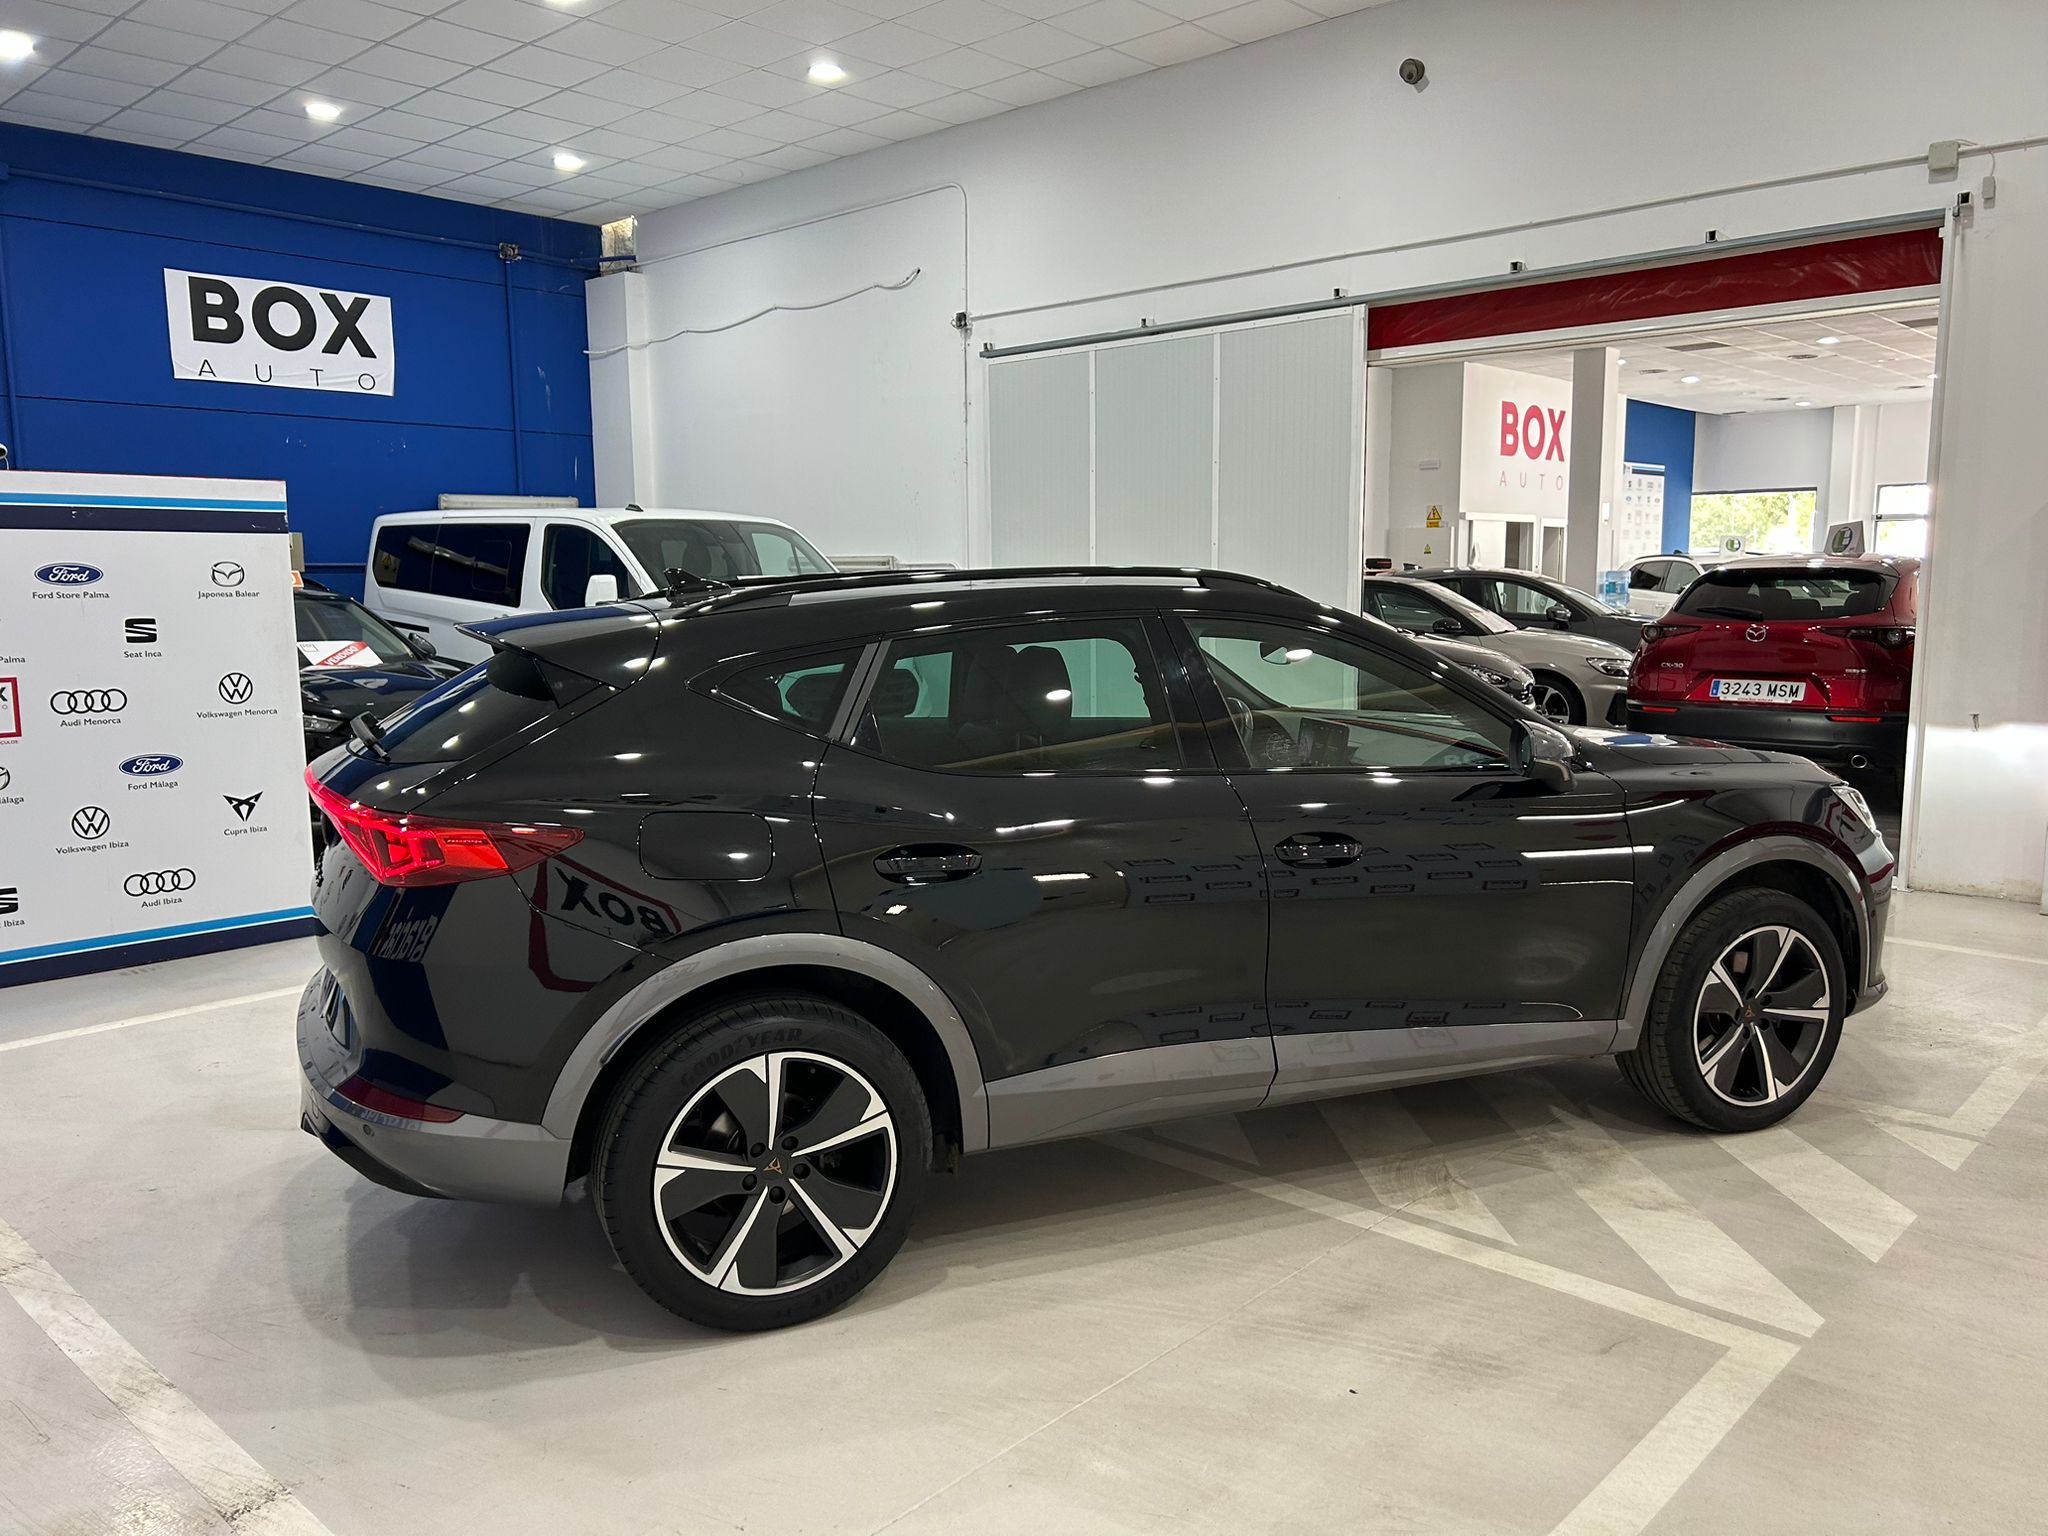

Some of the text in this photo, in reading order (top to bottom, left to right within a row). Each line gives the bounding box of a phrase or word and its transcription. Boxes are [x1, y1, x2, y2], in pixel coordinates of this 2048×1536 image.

[188, 276, 377, 359] BOX
[199, 359, 376, 391] AUTO
[1500, 400, 1566, 462] BOX
[1499, 470, 1564, 491] AUTO
[48, 566, 90, 582] Ford
[32, 591, 110, 599] Ford Store Palma
[198, 590, 260, 599] Japonesa Balear
[1720, 682, 1800, 699] 3243 MSM
[196, 708, 278, 719] Volkswagen Menorca
[60, 718, 121, 727] Audi Menorca
[132, 757, 171, 773] Ford
[127, 782, 148, 790] Ford
[223, 828, 248, 836] Cupra
[55, 841, 130, 855] Volkswagen Ibiza
[141, 897, 183, 908] Audi Ibiza
[3, 919, 25, 928] Ibiza
